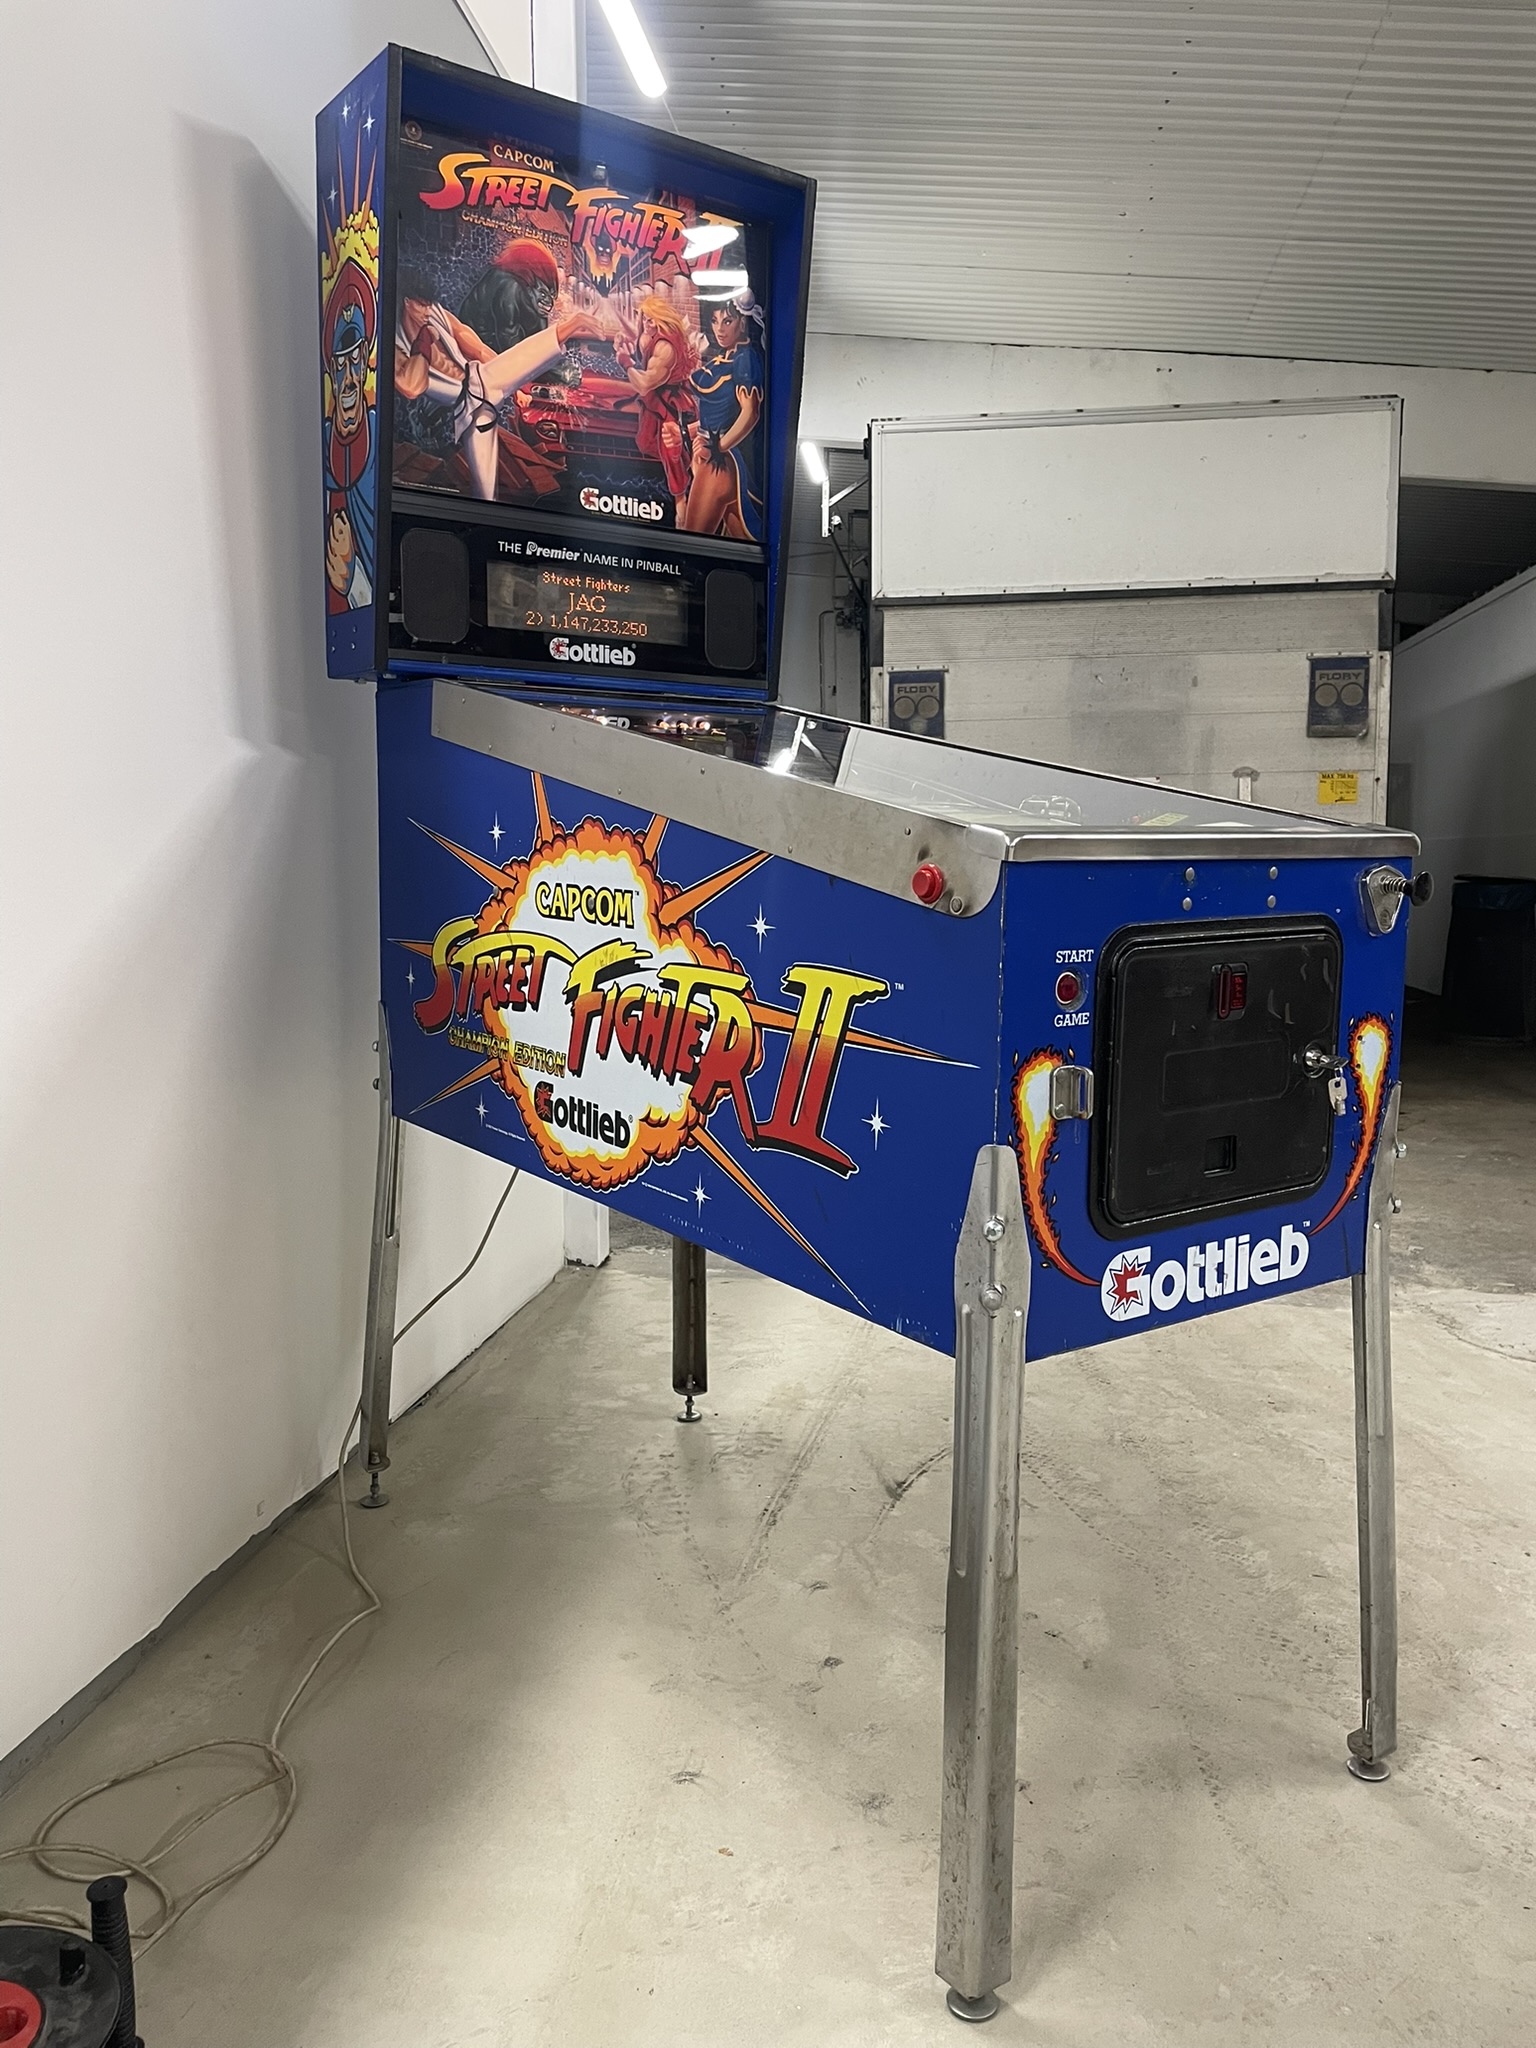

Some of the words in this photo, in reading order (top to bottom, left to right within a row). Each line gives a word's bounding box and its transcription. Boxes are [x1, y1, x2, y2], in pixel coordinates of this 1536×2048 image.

[493, 144, 555, 173] CAPCOM
[419, 152, 577, 211] STREET
[567, 187, 692, 274] FIGHTER
[461, 209, 522, 235] CHAMPION
[524, 228, 570, 248] EDITION
[579, 486, 664, 521] Gottlieb
[497, 540, 522, 555] THE
[525, 541, 580, 561] Premier
[583, 553, 620, 567] NAME
[621, 557, 634, 569] IN
[636, 559, 682, 575] PINBALL
[542, 571, 581, 588] Street
[585, 576, 631, 593] Fighters
[567, 593, 607, 614] JAG
[525, 611, 544, 627] 2)
[550, 615, 648, 637] 1,147,233,250
[549, 637, 636, 666] Gottlieb
[897, 685, 937, 694] FLOBY
[1319, 672, 1362, 681] FLOBY
[535, 880, 635, 929] CAPCOM
[1055, 949, 1094, 963] START
[1054, 1012, 1090, 1028] GAME
[414, 915, 578, 1034] STREET
[565, 938, 765, 1147] FIGHTER
[754, 963, 889, 1177] II
[448, 1026, 511, 1062] CHAMPION
[513, 1040, 567, 1078] EDITION
[534, 1083, 631, 1149] Gottlieb
[1100, 1224, 1310, 1323] Gottlieb
